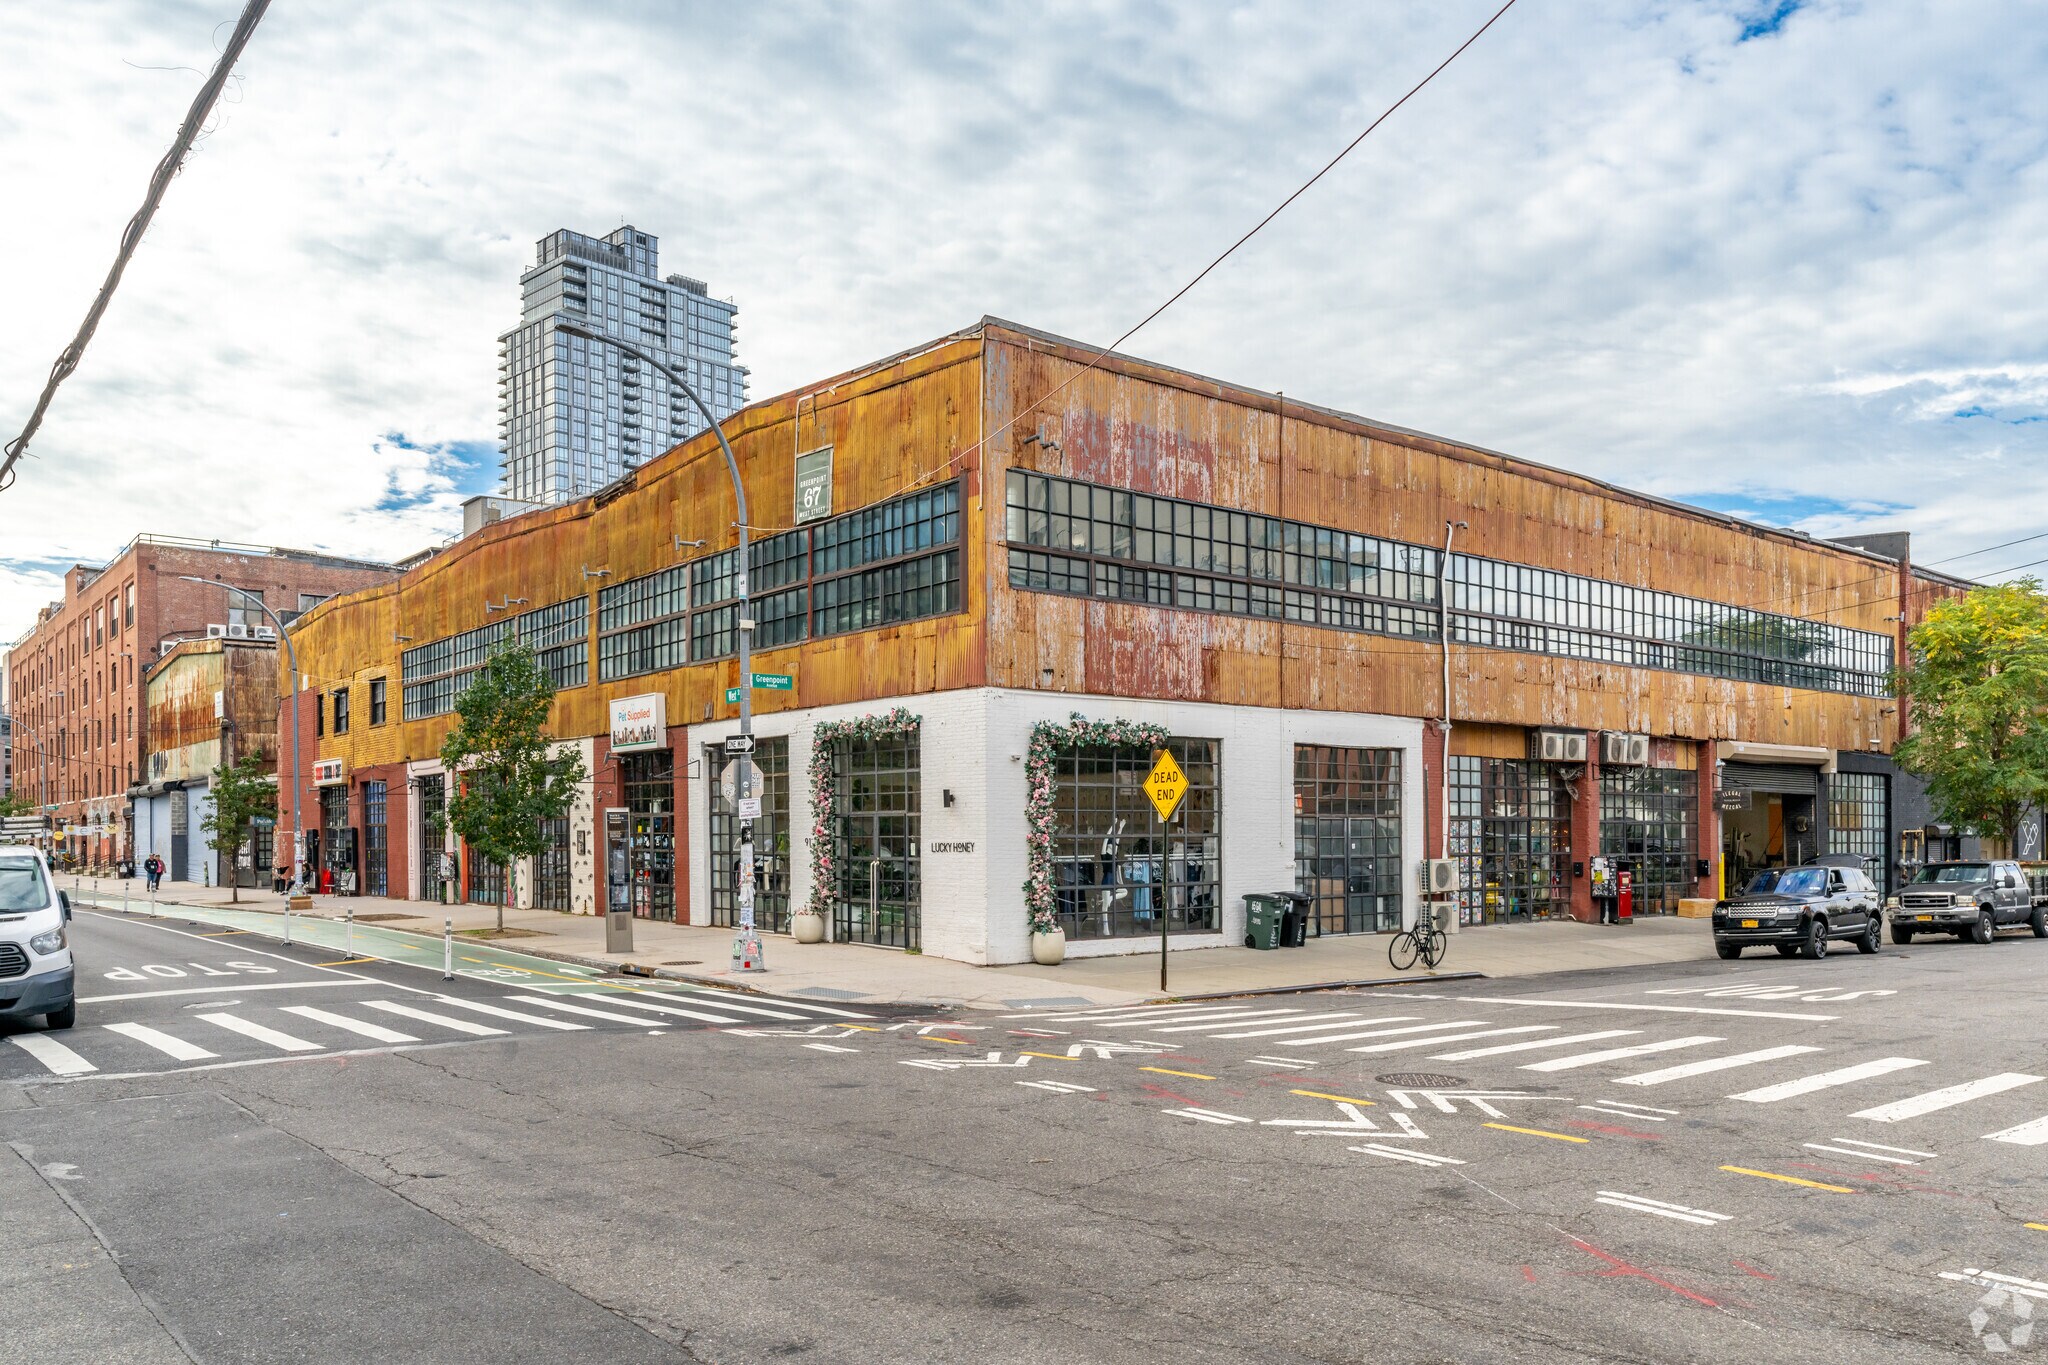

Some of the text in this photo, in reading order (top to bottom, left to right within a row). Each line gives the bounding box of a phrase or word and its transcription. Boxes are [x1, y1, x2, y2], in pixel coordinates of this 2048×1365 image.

[800, 475, 827, 488] GREENPOINT
[803, 485, 822, 508] 67
[799, 506, 825, 518] WEST STREET
[755, 674, 788, 685] Greenpoint
[618, 707, 651, 722] Pet Supplied
[728, 740, 737, 749] ONE
[1154, 771, 1178, 784] DEAD
[1157, 788, 1175, 801] END
[931, 842, 975, 853] LUCKY HONEY
[103, 961, 279, 981] STOP
[1644, 983, 1899, 1002] STOP
